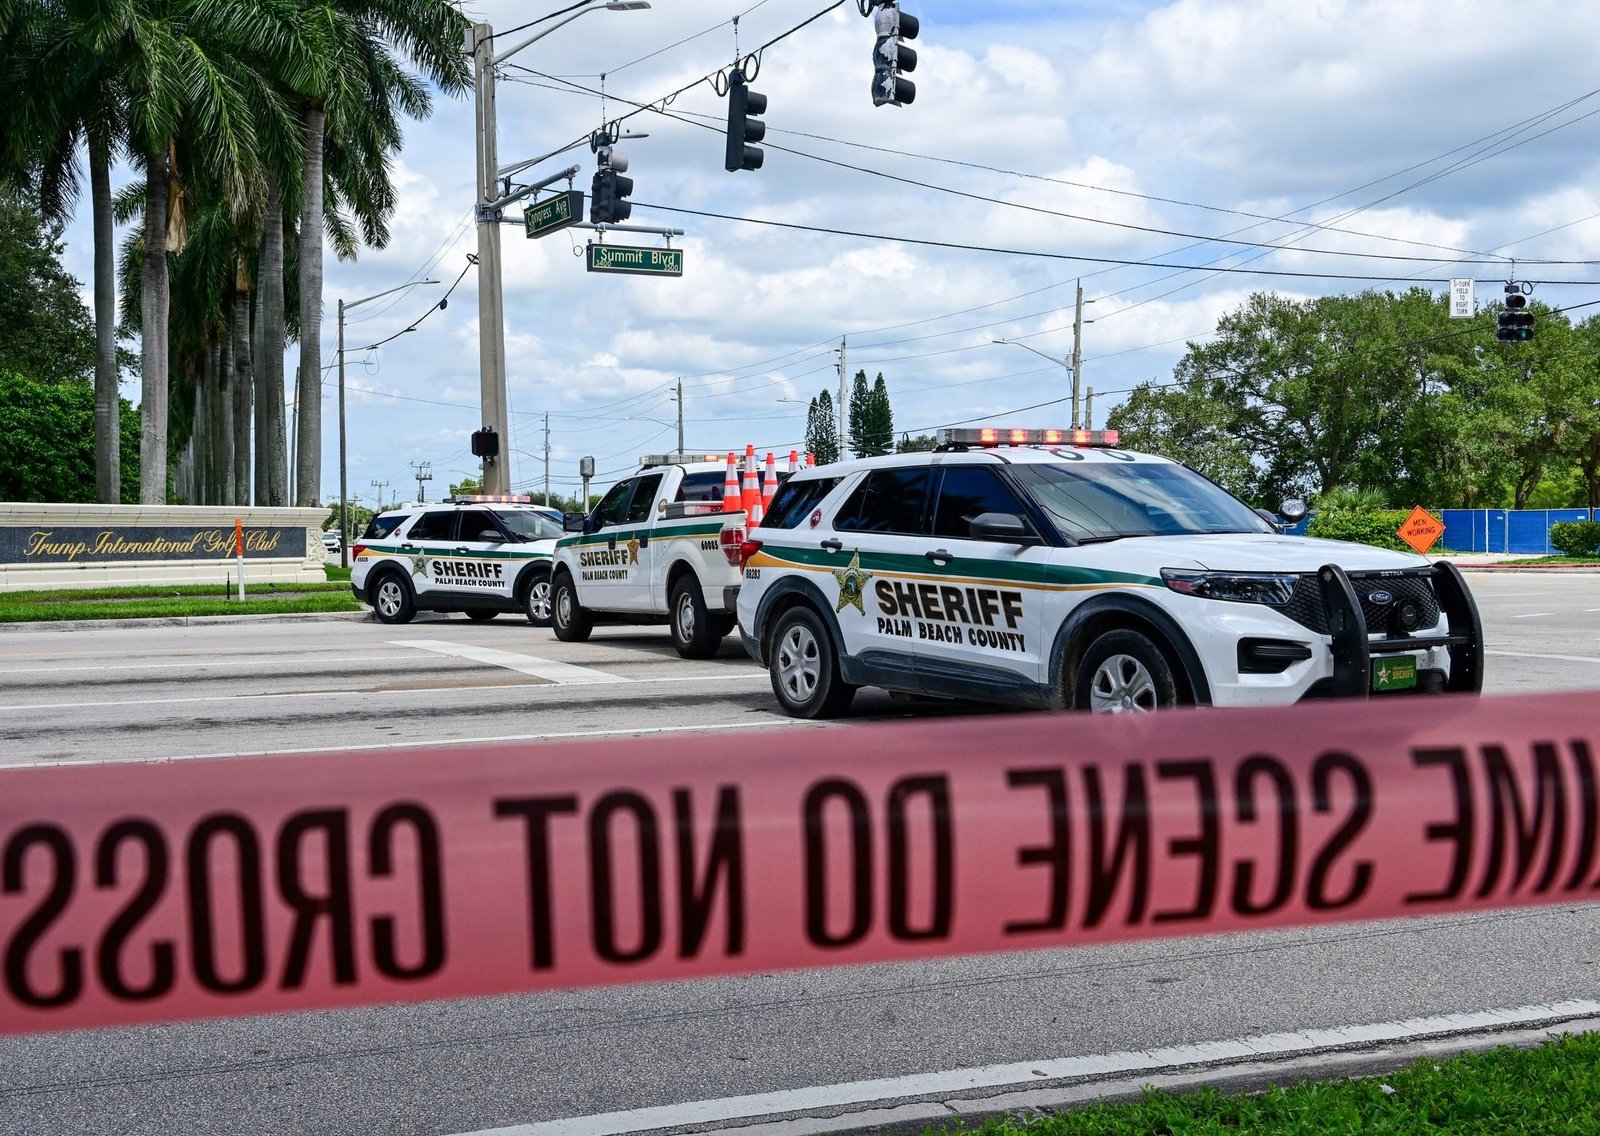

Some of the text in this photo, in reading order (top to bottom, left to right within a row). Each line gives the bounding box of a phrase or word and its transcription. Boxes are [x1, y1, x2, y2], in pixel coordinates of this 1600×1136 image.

[527, 206, 552, 227] Congress
[556, 199, 568, 215] Ave
[595, 259, 612, 268] 3400
[600, 248, 675, 266] Summit Blvd
[663, 264, 679, 272] 3500
[1407, 527, 1436, 537] WORKING
[1412, 519, 1427, 527] MEN
[23, 530, 281, 561] Trump International Golf Club
[580, 549, 628, 567] SHERIFF
[432, 560, 503, 579] SHERIFF
[582, 569, 628, 580] PALM BEACH COUNTY
[434, 577, 506, 588] PALM BEACH COUNTY
[874, 579, 1024, 629] SHERIFF
[876, 616, 1026, 653] PALM BEACH COUNTY
